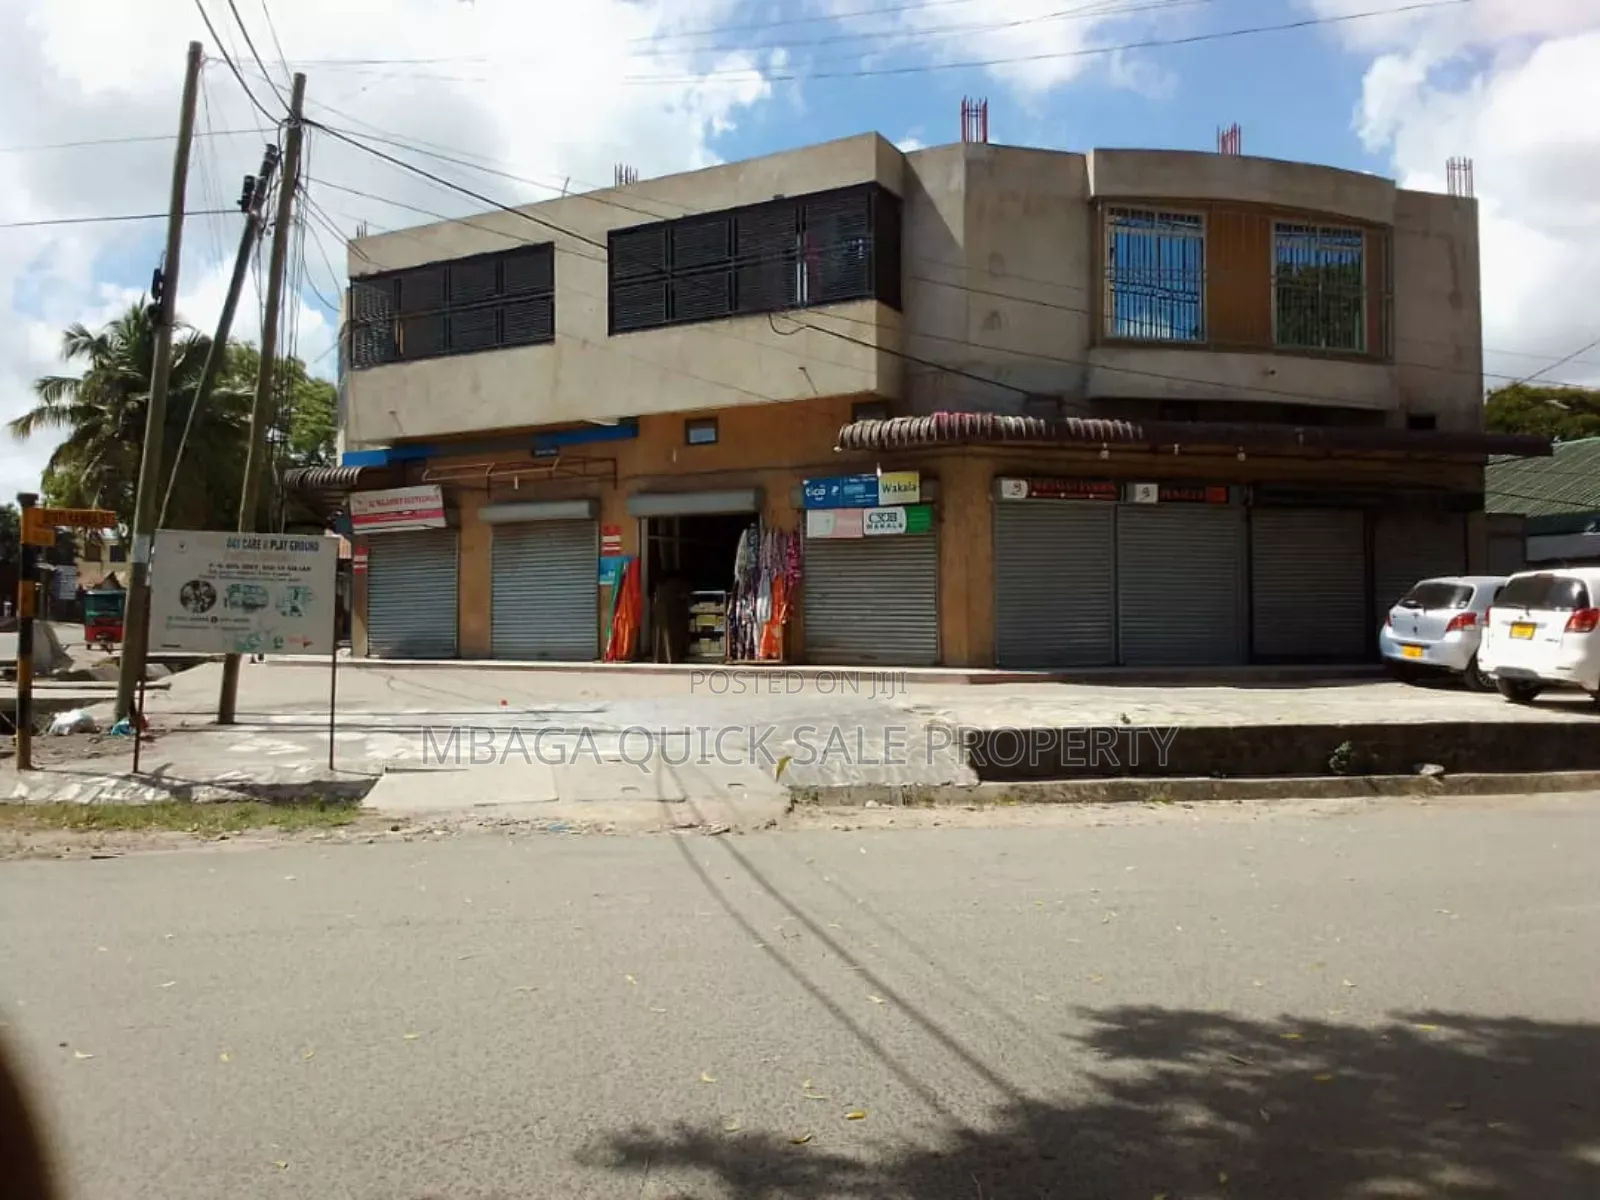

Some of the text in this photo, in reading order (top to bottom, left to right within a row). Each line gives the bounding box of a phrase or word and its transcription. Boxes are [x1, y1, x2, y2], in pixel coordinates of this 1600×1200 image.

[881, 481, 917, 494] Wakala
[242, 537, 261, 551] CARE
[270, 539, 288, 551] PLAY
